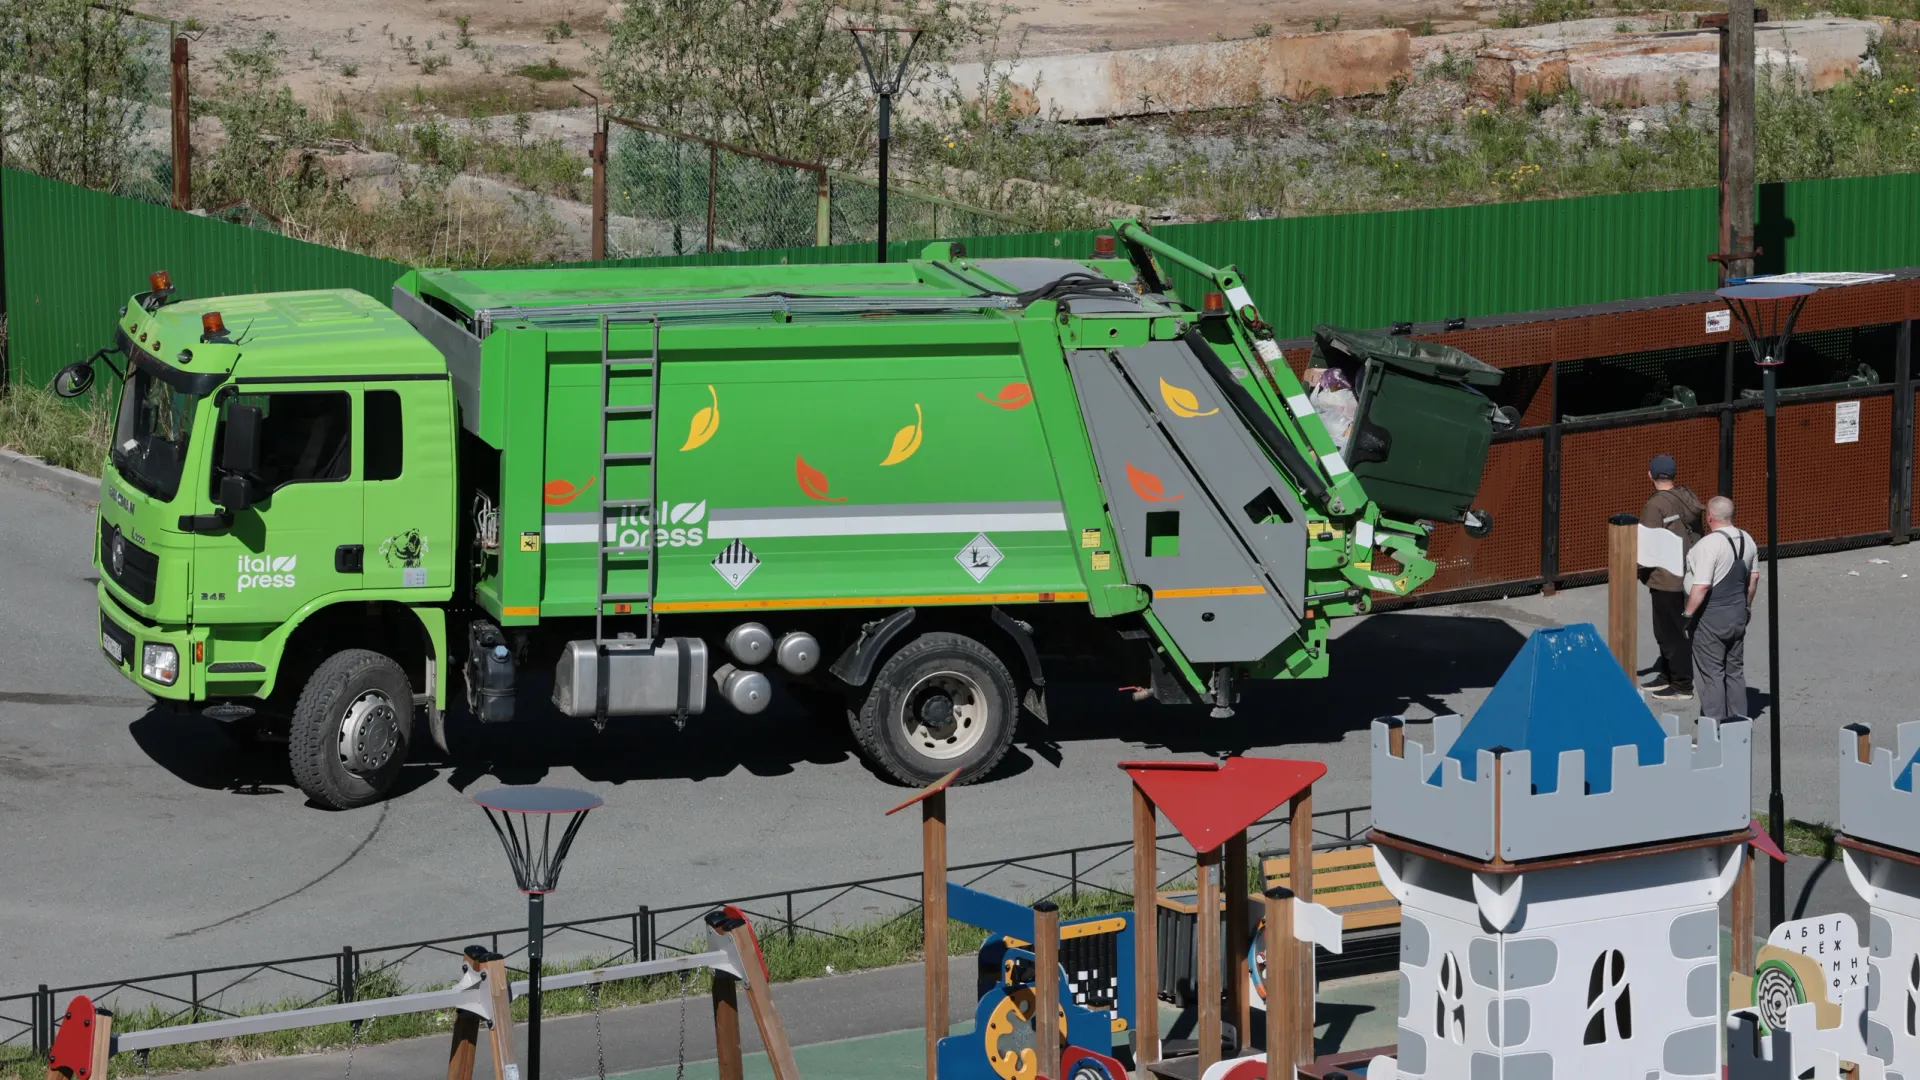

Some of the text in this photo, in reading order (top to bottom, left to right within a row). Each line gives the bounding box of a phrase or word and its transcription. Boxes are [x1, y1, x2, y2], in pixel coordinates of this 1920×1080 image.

[620, 501, 668, 526] ital
[618, 527, 704, 555] press
[238, 554, 271, 573] ital
[237, 573, 296, 593] press
[732, 573, 738, 582] 9
[1784, 921, 1841, 940] А Б В Г
[1819, 941, 1824, 954] Ё
[1834, 940, 1841, 951] Ж
[1833, 961, 1840, 971] М
[1851, 957, 1858, 968] Н
[1833, 978, 1840, 988] Ф
[1850, 975, 1857, 985] Х
